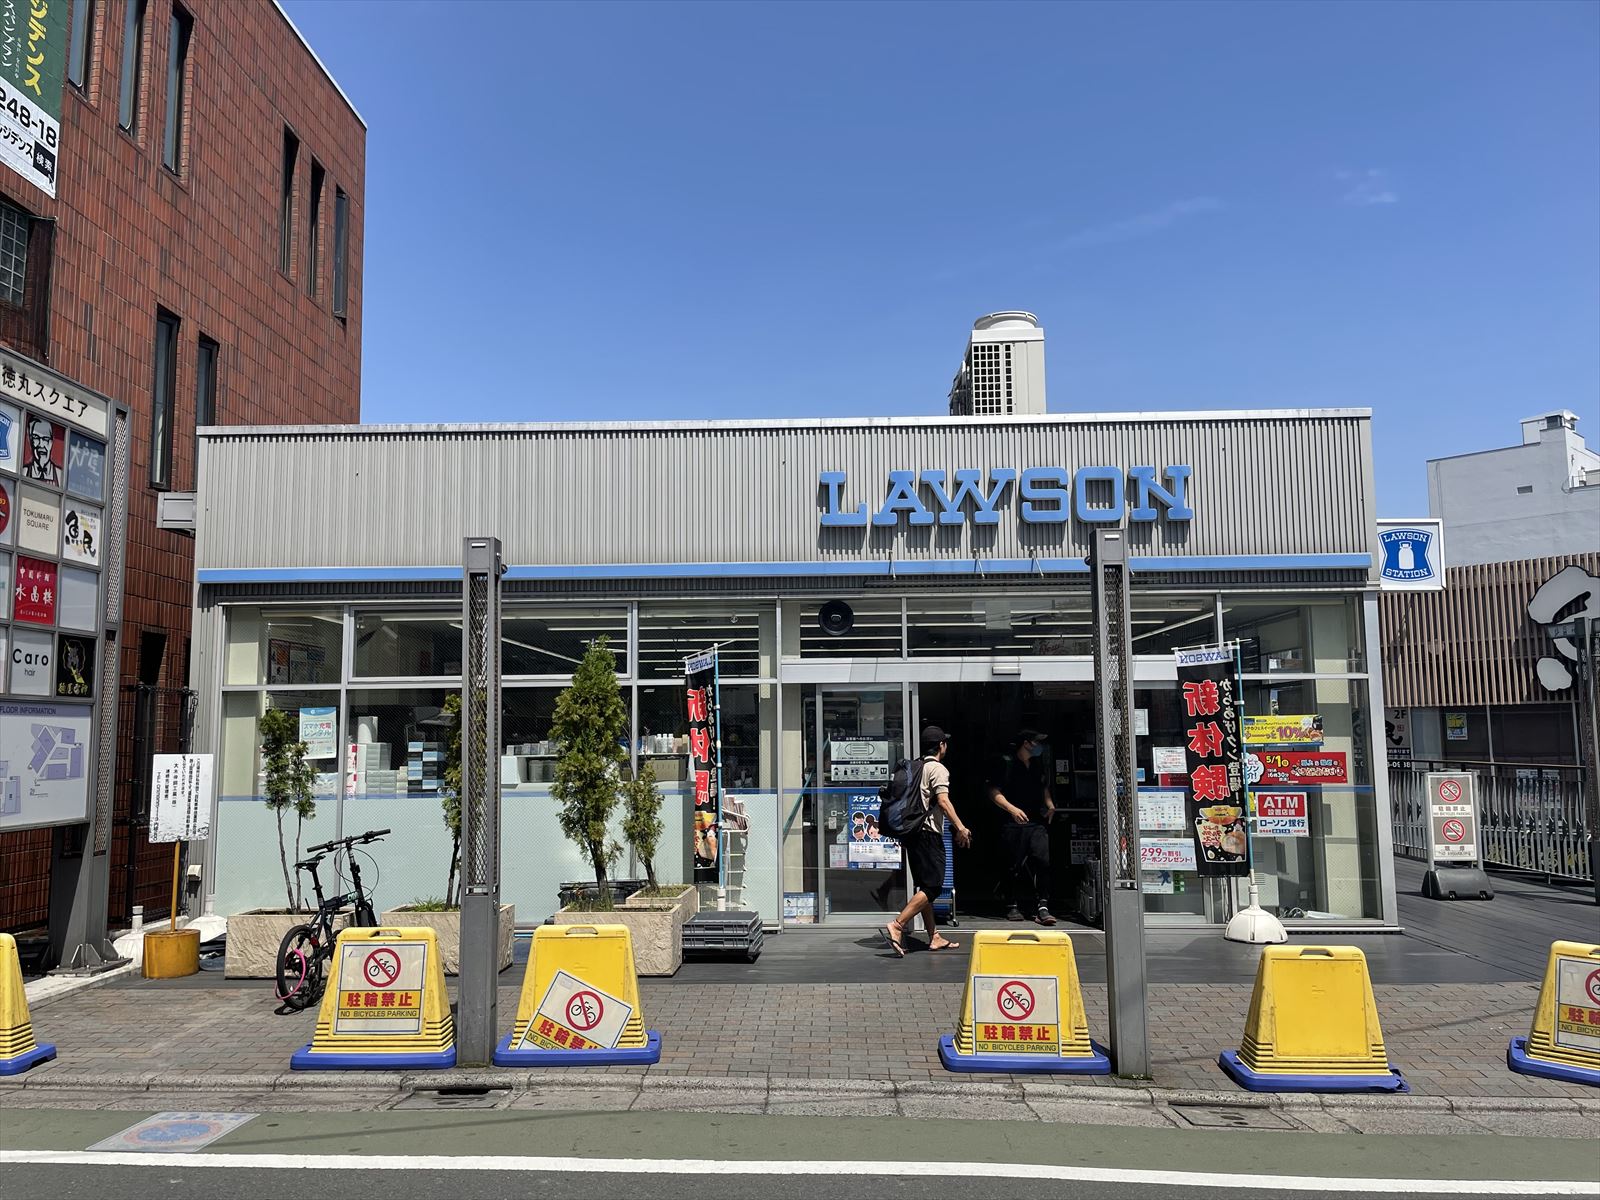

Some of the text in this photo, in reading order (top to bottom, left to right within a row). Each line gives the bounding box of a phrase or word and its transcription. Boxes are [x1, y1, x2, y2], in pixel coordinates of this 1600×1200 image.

[0, 125, 33, 159] ジデンス
[2, 365, 88, 418] 徳丸スクエア
[819, 464, 1194, 528] LAWSON
[23, 508, 54, 523] TOKUMARU
[26, 519, 50, 531] SQUARE
[1383, 532, 1427, 543] LAWSON
[1385, 568, 1428, 578] STATION
[12, 649, 49, 666] Caro
[24, 668, 36, 677] hair
[20, 706, 57, 715] INFORMATION
[1394, 710, 1406, 719] 2F
[1263, 796, 1299, 809] ATM
[1260, 819, 1305, 828] ローソン銀行
[346, 992, 412, 1007] 駐輪禁止
[984, 1025, 1050, 1041] 駐輪禁止
[1561, 1023, 1573, 1031] NO
[528, 1033, 539, 1042] NO
[539, 1019, 598, 1049] 駐輪禁
[991, 1043, 1025, 1051] BICYCLES
[1026, 1044, 1057, 1052] PARKING
